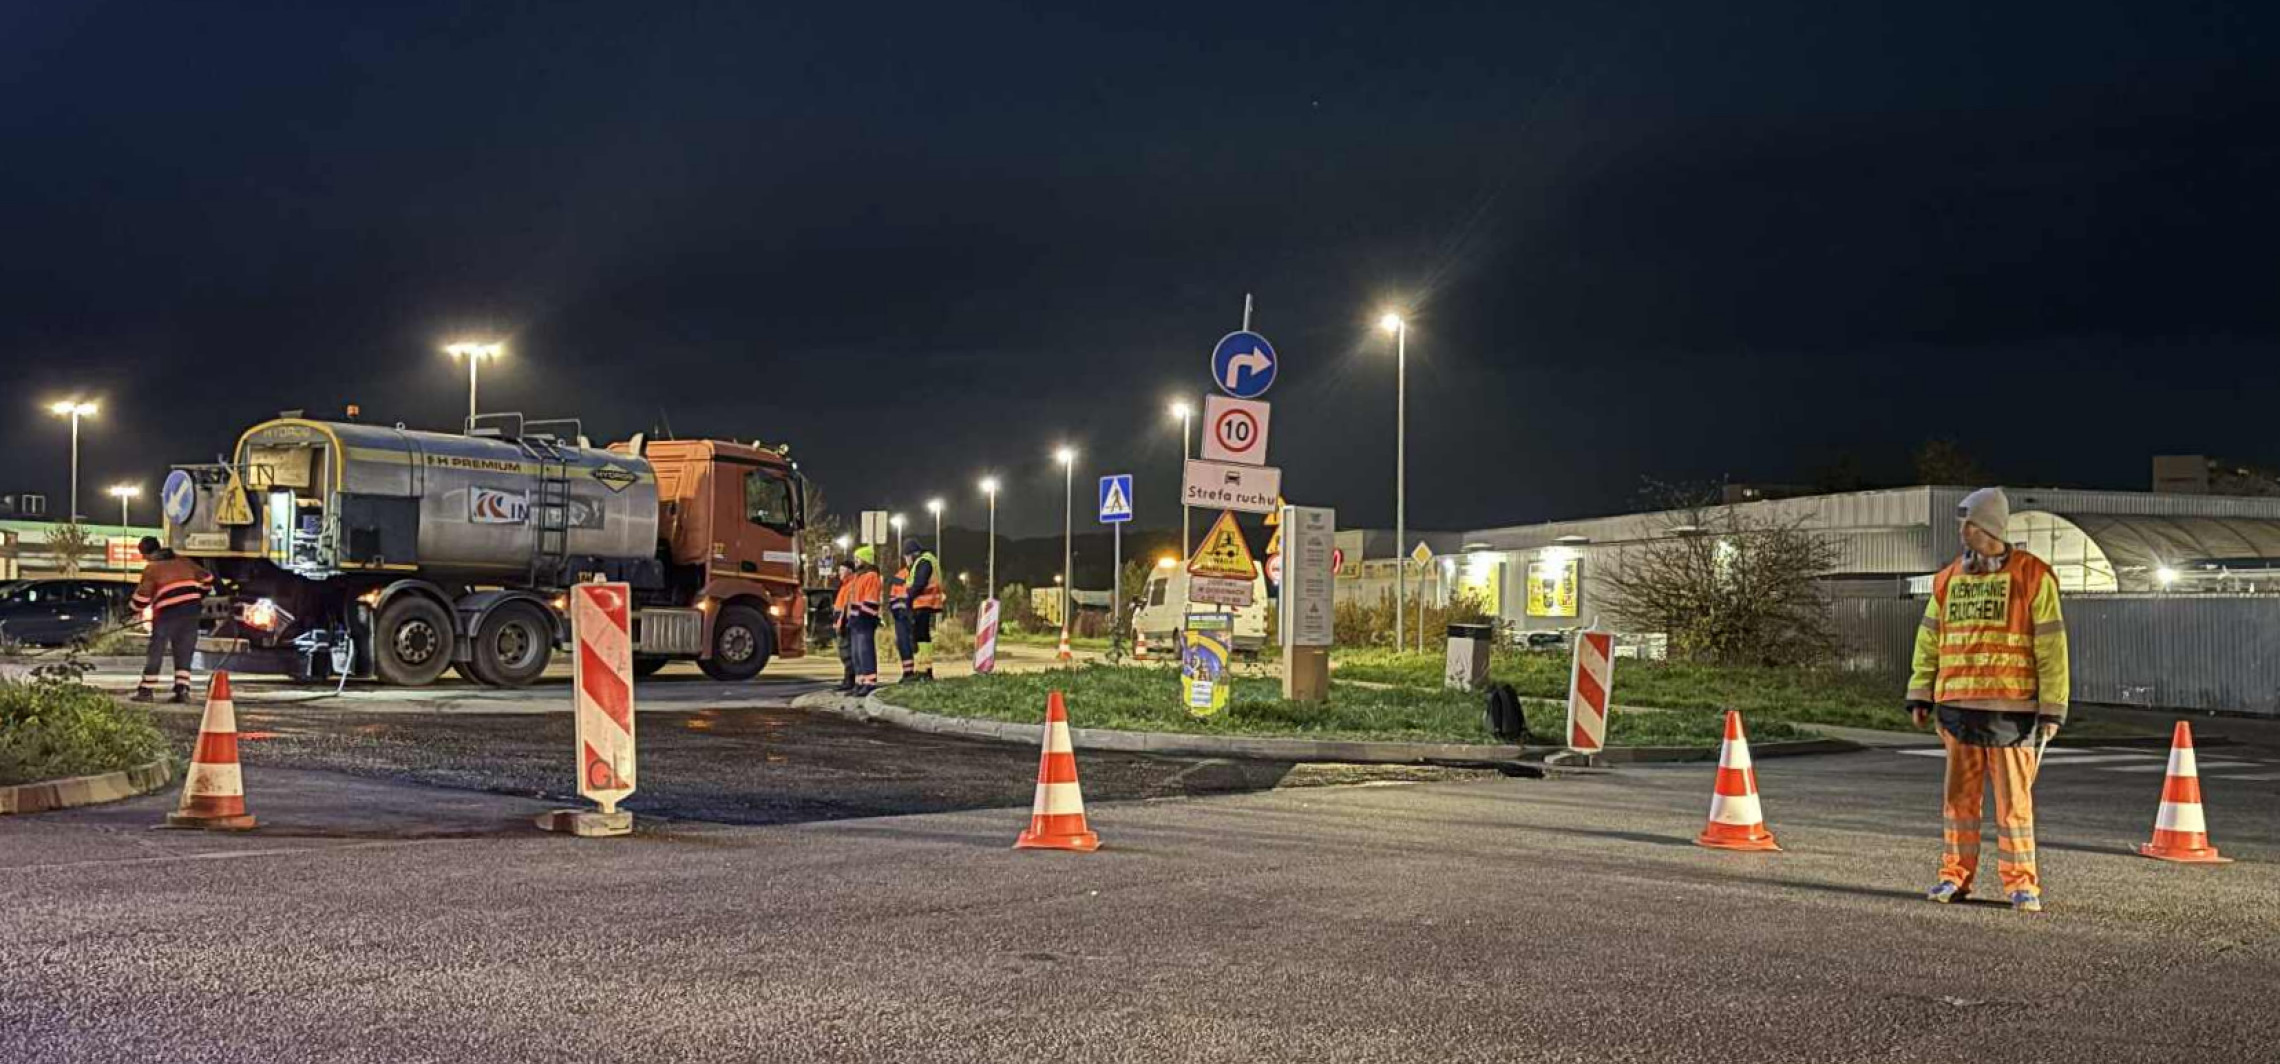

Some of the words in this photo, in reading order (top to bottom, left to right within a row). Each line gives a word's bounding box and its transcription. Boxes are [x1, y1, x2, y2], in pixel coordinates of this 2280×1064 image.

[1225, 420, 1249, 442] 10
[452, 458, 520, 471] PREMIUM
[1188, 486, 1232, 501] Strefa
[1236, 493, 1275, 506] ruchu
[1951, 581, 2005, 598] KIEROWANIE
[1949, 601, 2005, 620] RUCHEM
